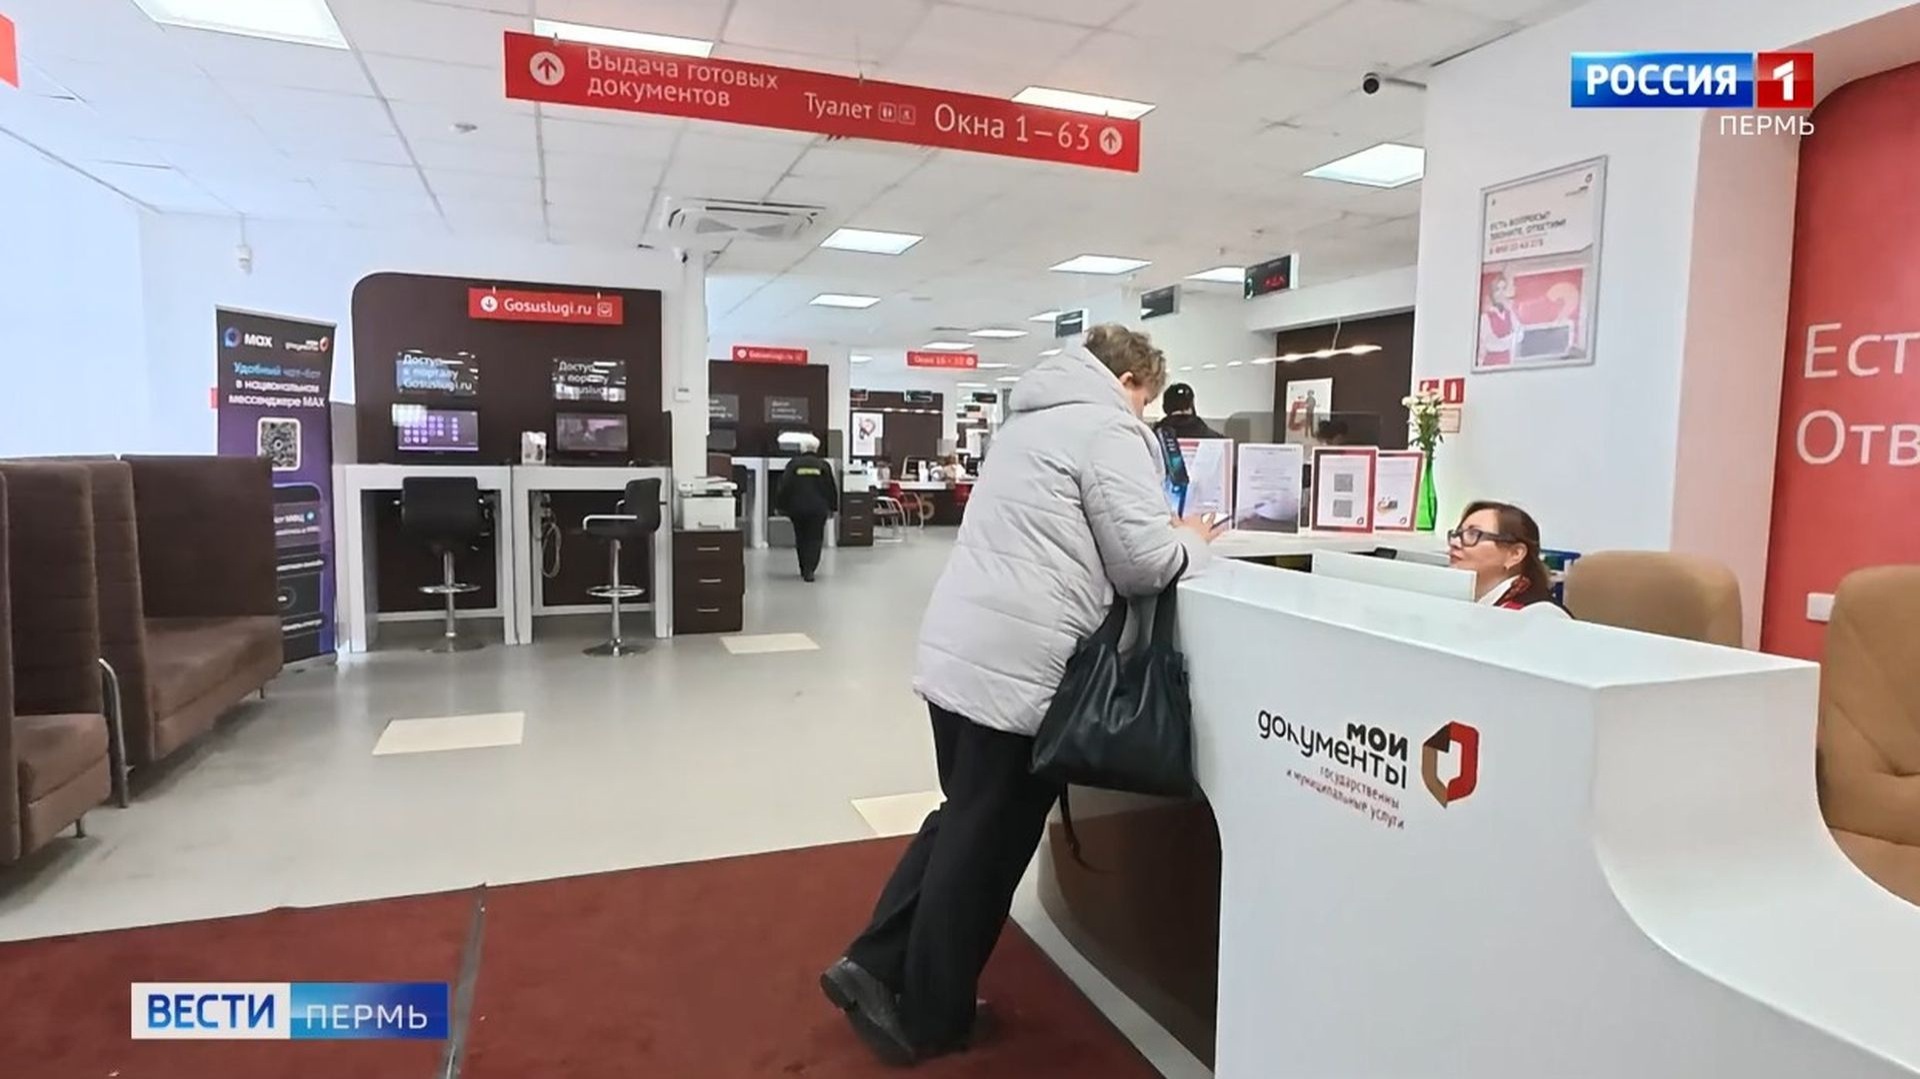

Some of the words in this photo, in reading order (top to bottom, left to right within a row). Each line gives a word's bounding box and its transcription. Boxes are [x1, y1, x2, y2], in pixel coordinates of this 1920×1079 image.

[587, 49, 679, 78] Выдача
[687, 63, 779, 90] готовых
[587, 76, 731, 108] документов
[803, 92, 873, 119] Туалет
[934, 103, 1005, 139] Окна
[503, 297, 593, 318] Gosuslugi.ru
[1804, 323, 1920, 378] Ест
[1797, 410, 1920, 465] Отв
[1257, 710, 1408, 790] документы
[1347, 723, 1409, 762] мои
